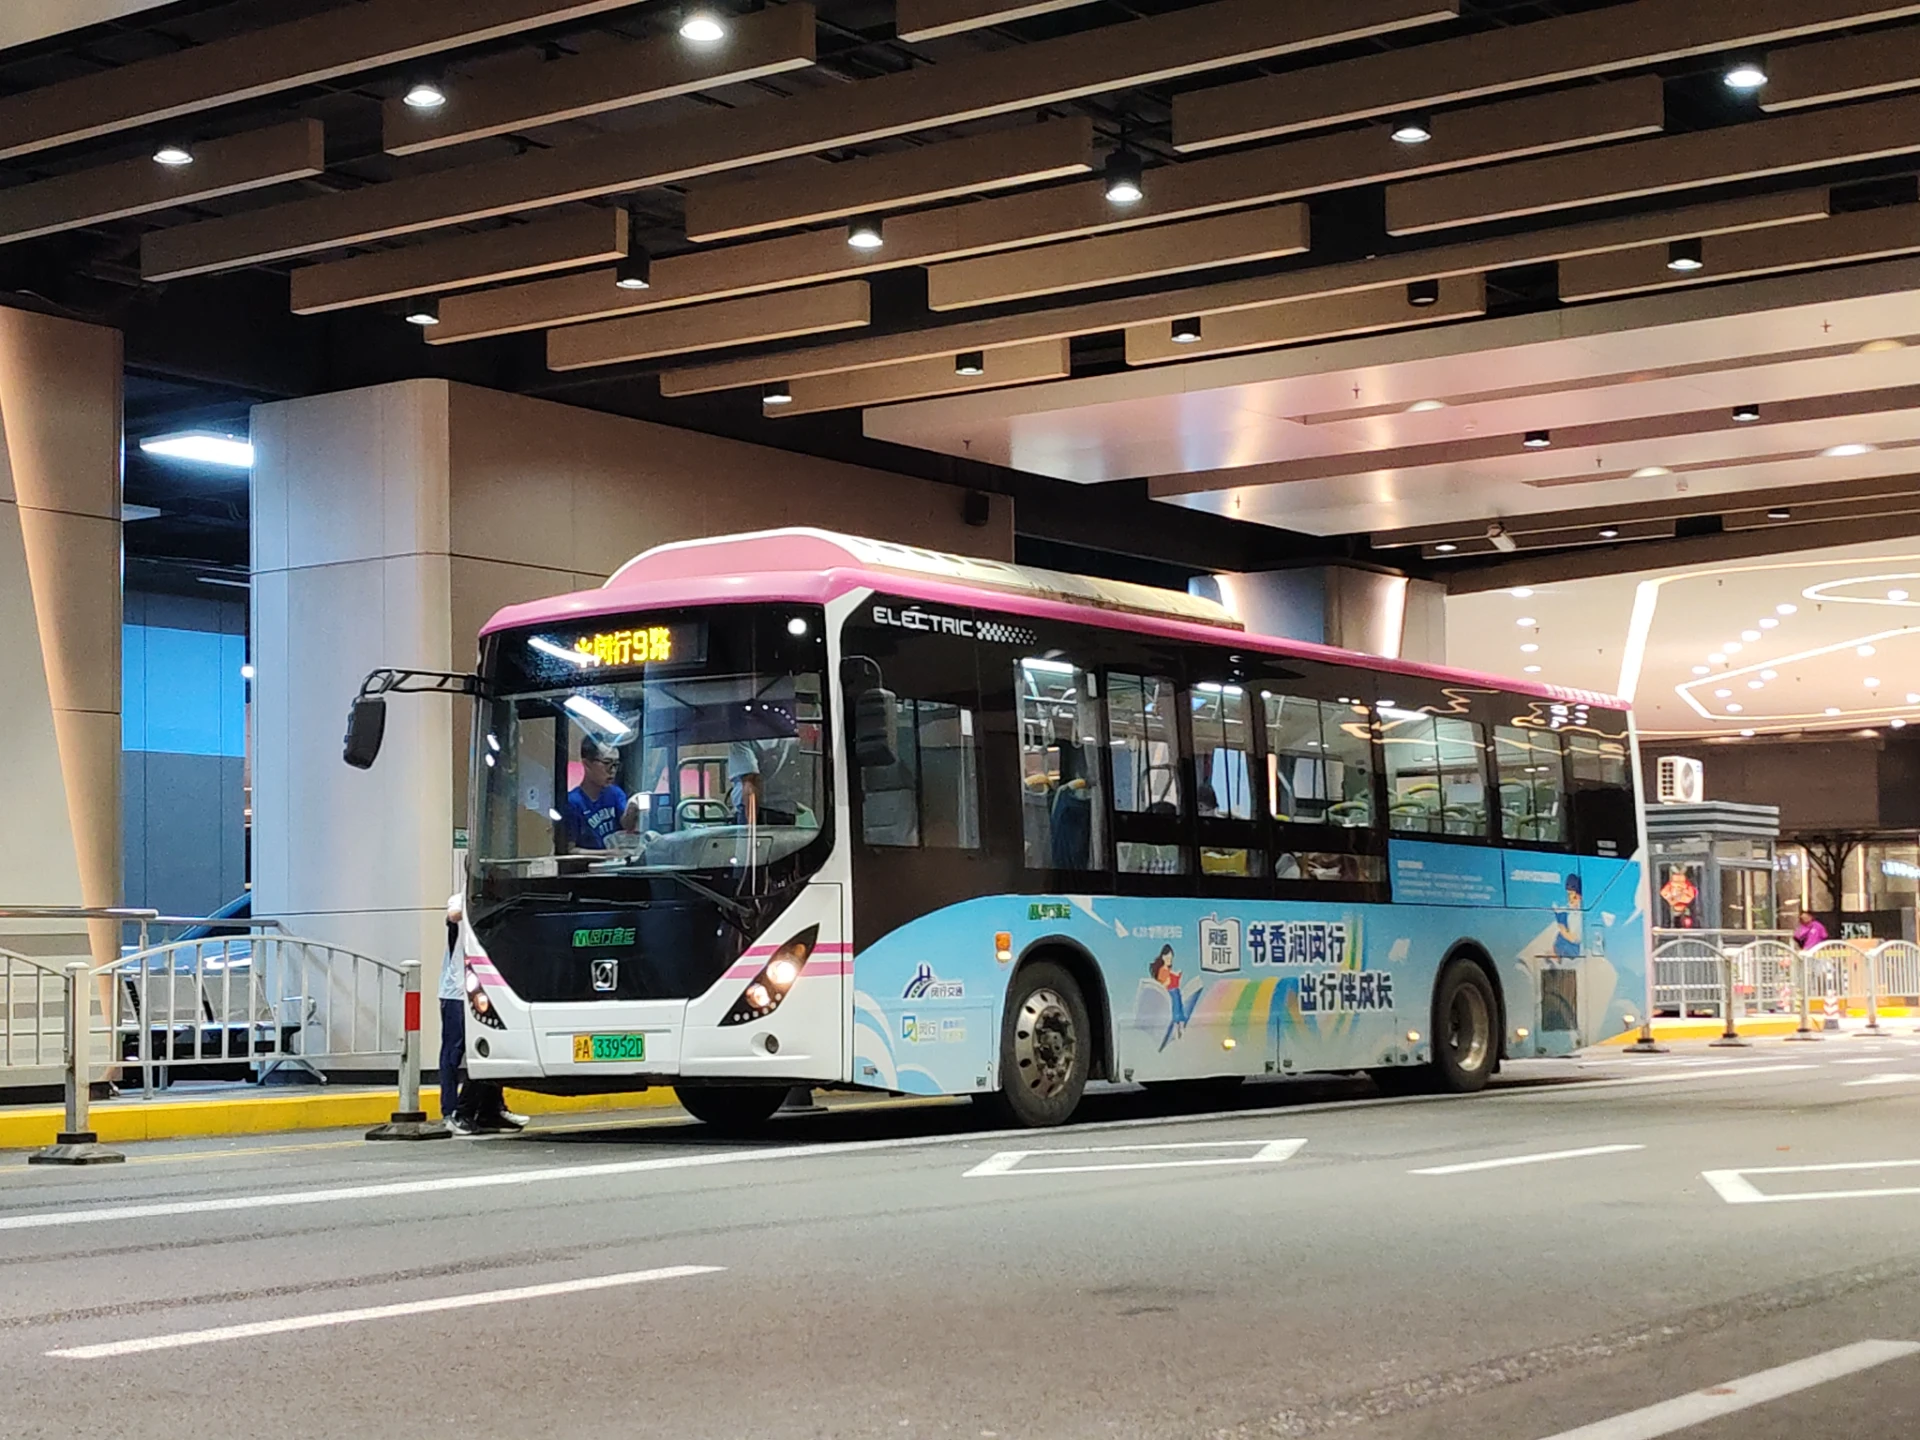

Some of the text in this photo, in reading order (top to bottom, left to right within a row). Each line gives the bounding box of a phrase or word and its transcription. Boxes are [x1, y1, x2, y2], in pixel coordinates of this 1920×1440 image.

[872, 605, 974, 638] ELECTRIC
[1248, 923, 1346, 964] 书香润闵行
[1300, 972, 1394, 1012] 出行伴成长
